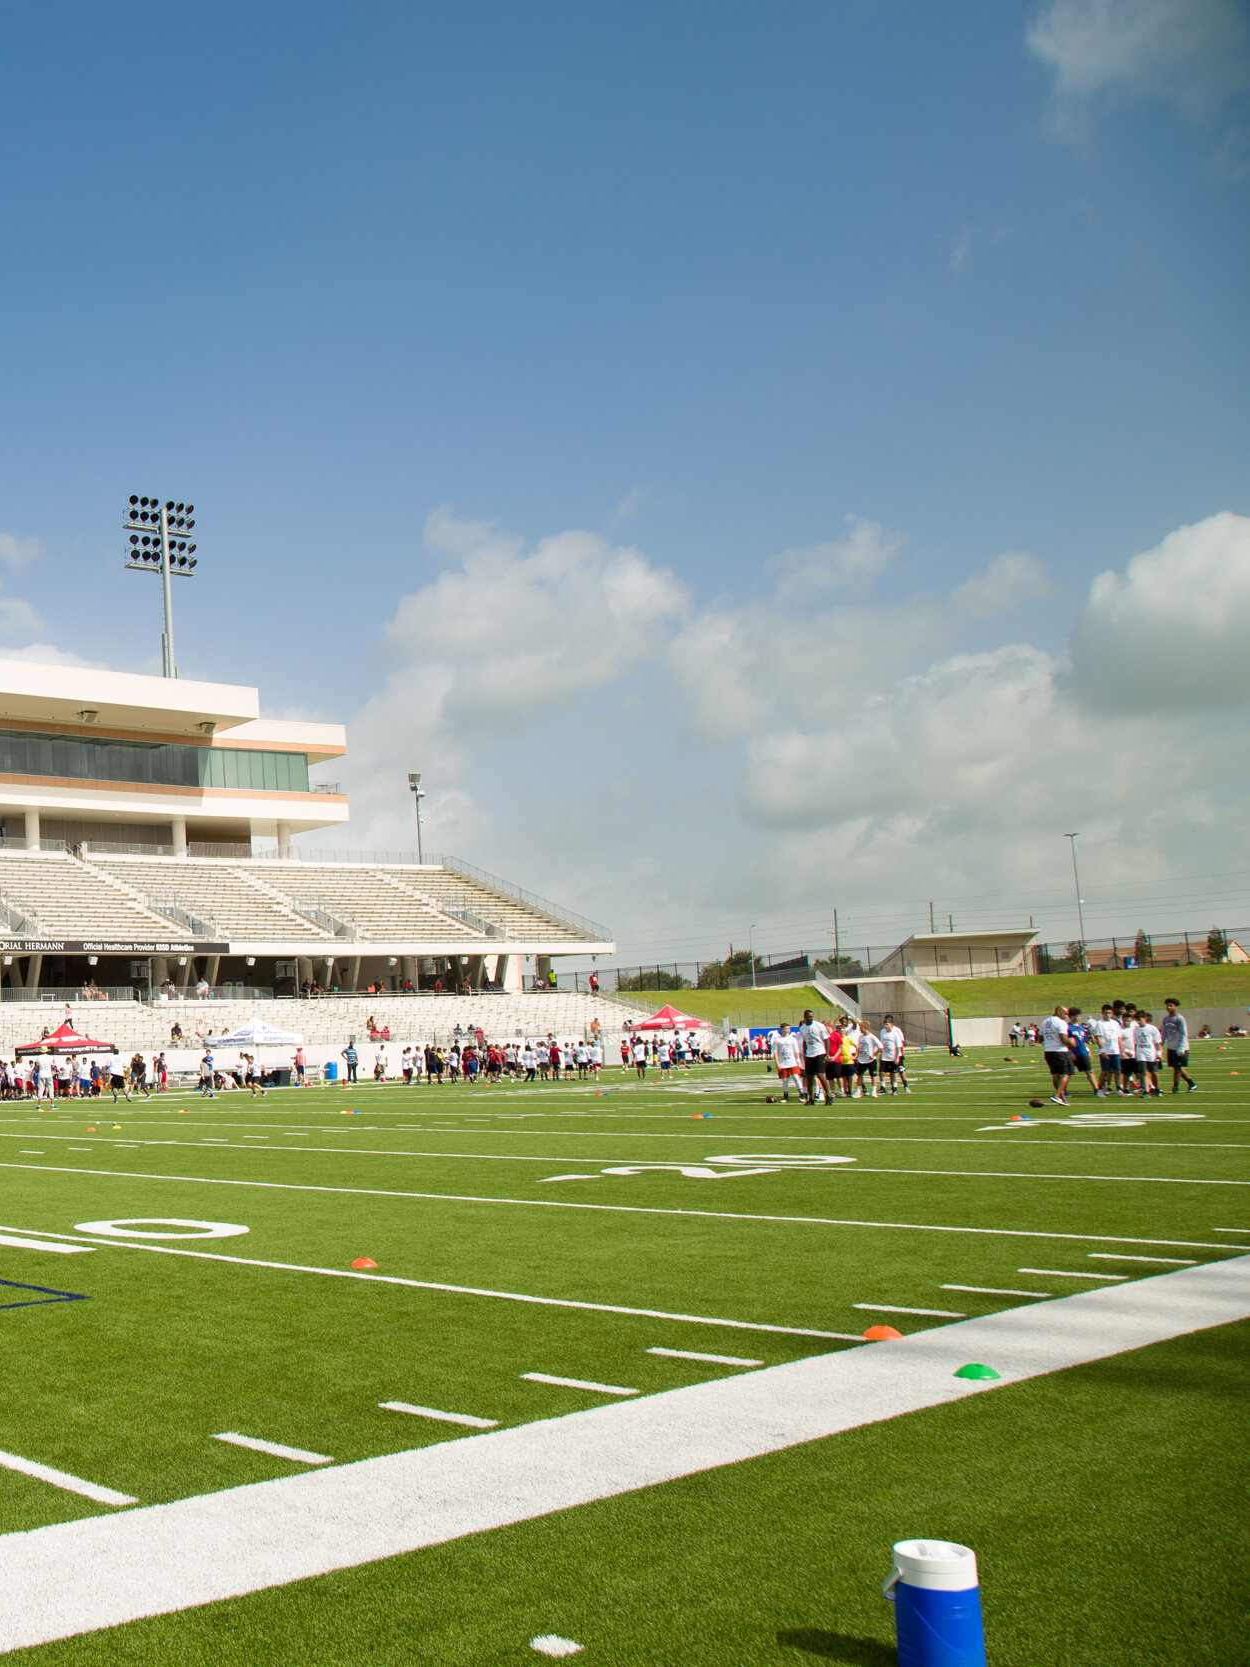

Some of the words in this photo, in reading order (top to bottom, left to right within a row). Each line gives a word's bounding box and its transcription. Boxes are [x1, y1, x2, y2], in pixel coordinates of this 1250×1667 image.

[25, 942, 64, 950] HERMANN
[104, 943, 132, 951] Healthcare
[134, 943, 155, 951] Provider
